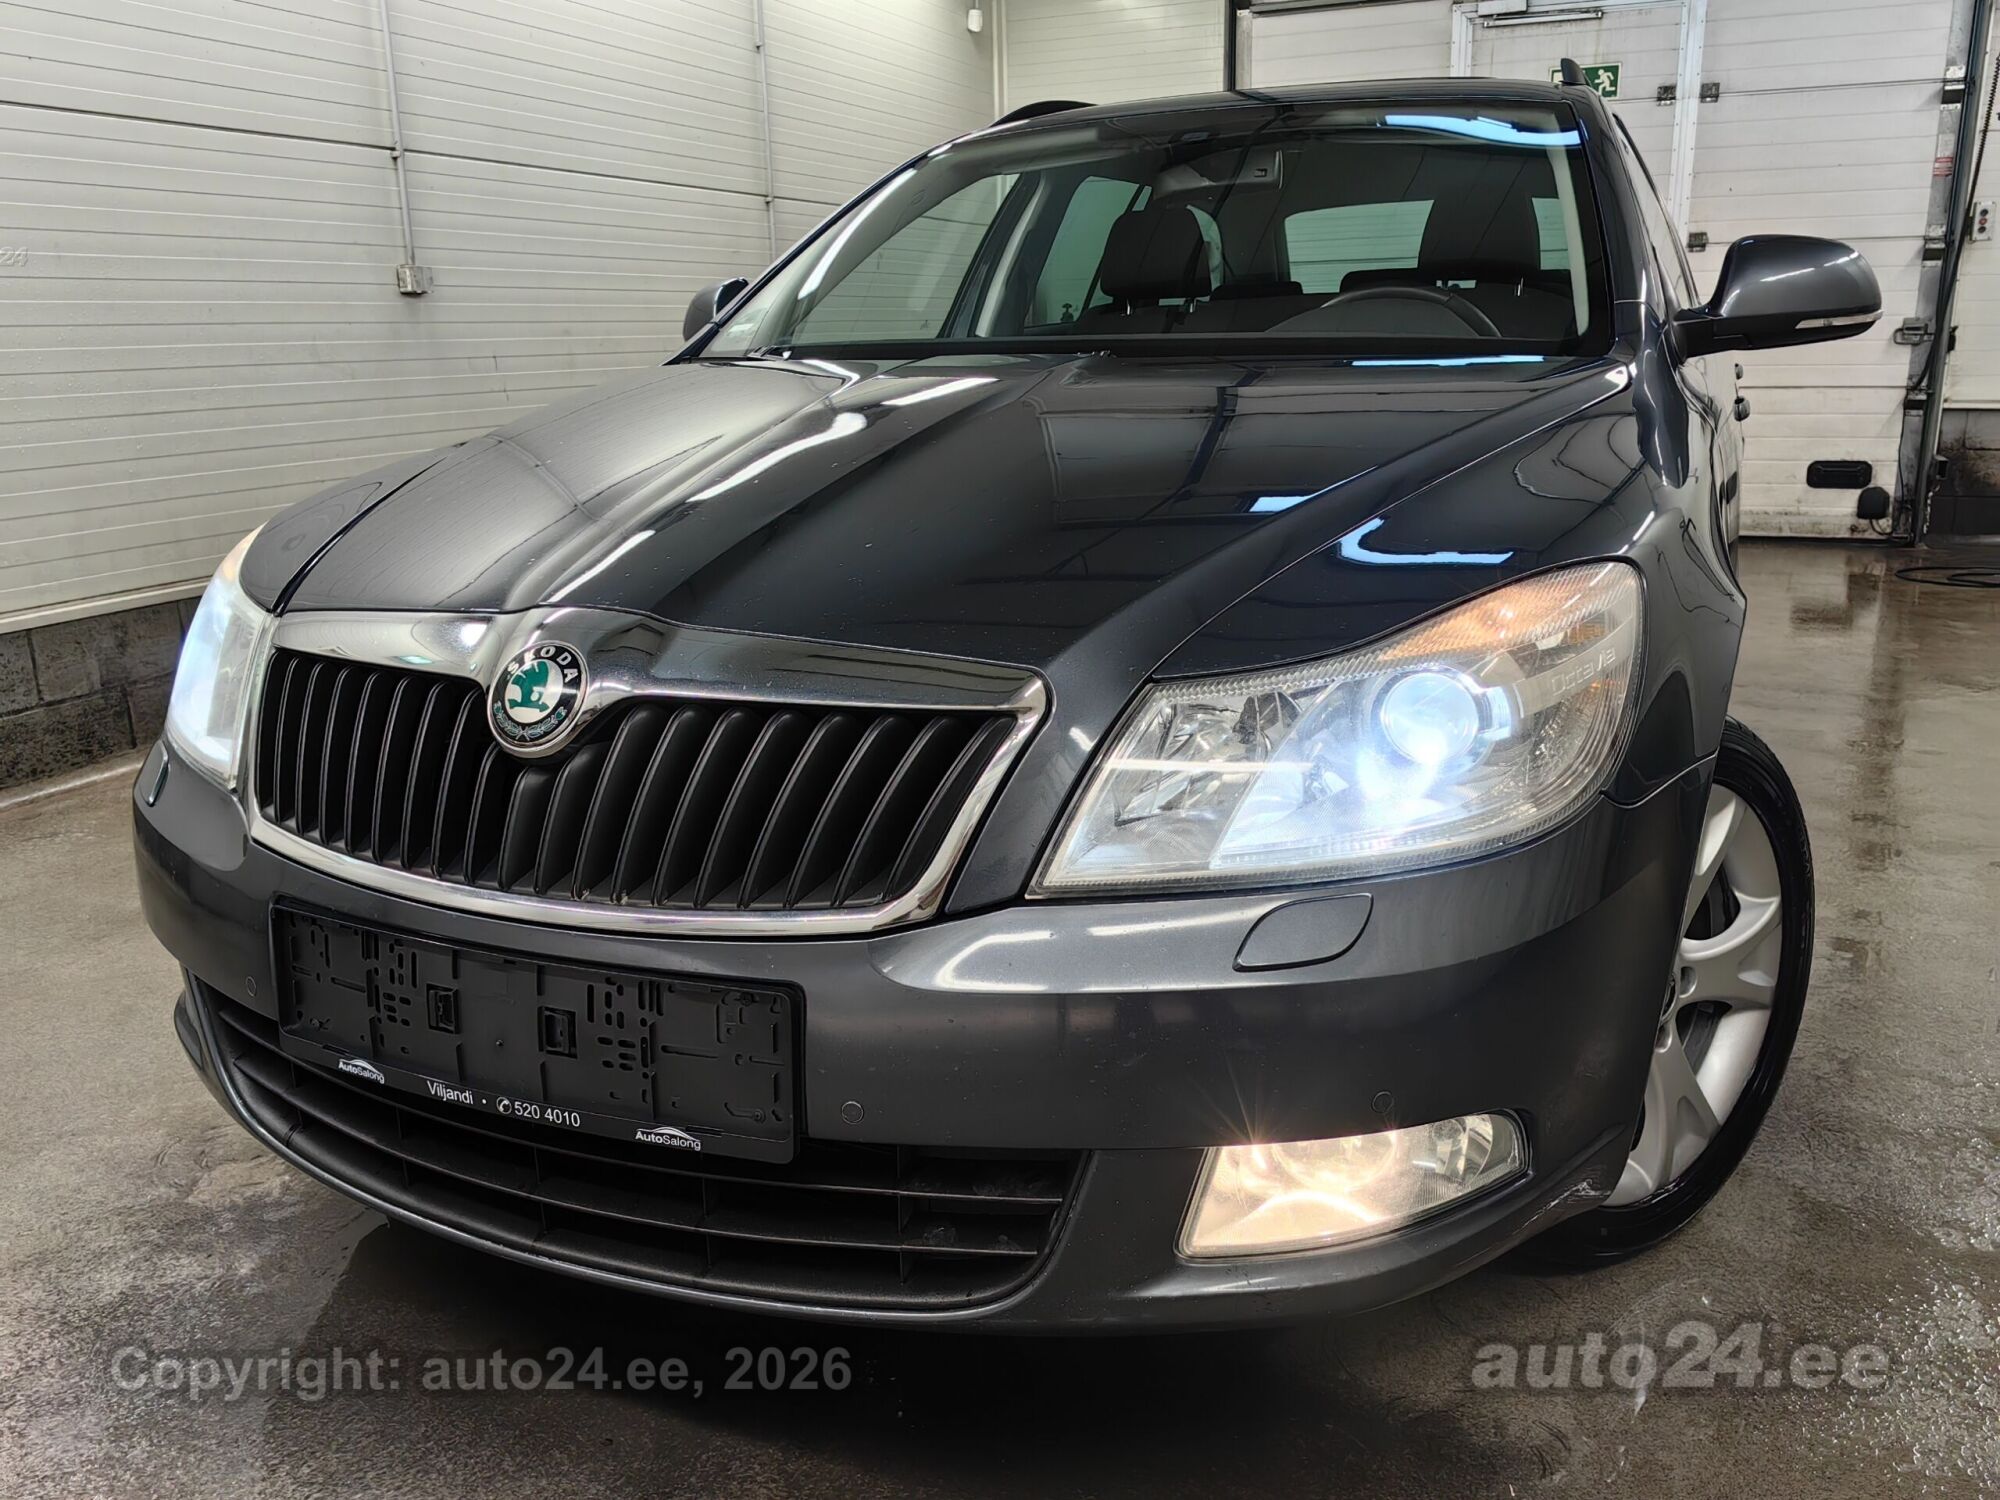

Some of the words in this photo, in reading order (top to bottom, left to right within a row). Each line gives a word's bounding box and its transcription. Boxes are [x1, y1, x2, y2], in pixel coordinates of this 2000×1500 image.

[338, 1061, 385, 1084] AutoSalong
[426, 1080, 474, 1105] Viljandi
[514, 1101, 541, 1119] 520
[544, 1108, 581, 1127] 4010
[635, 1130, 702, 1151] AutoSalong
